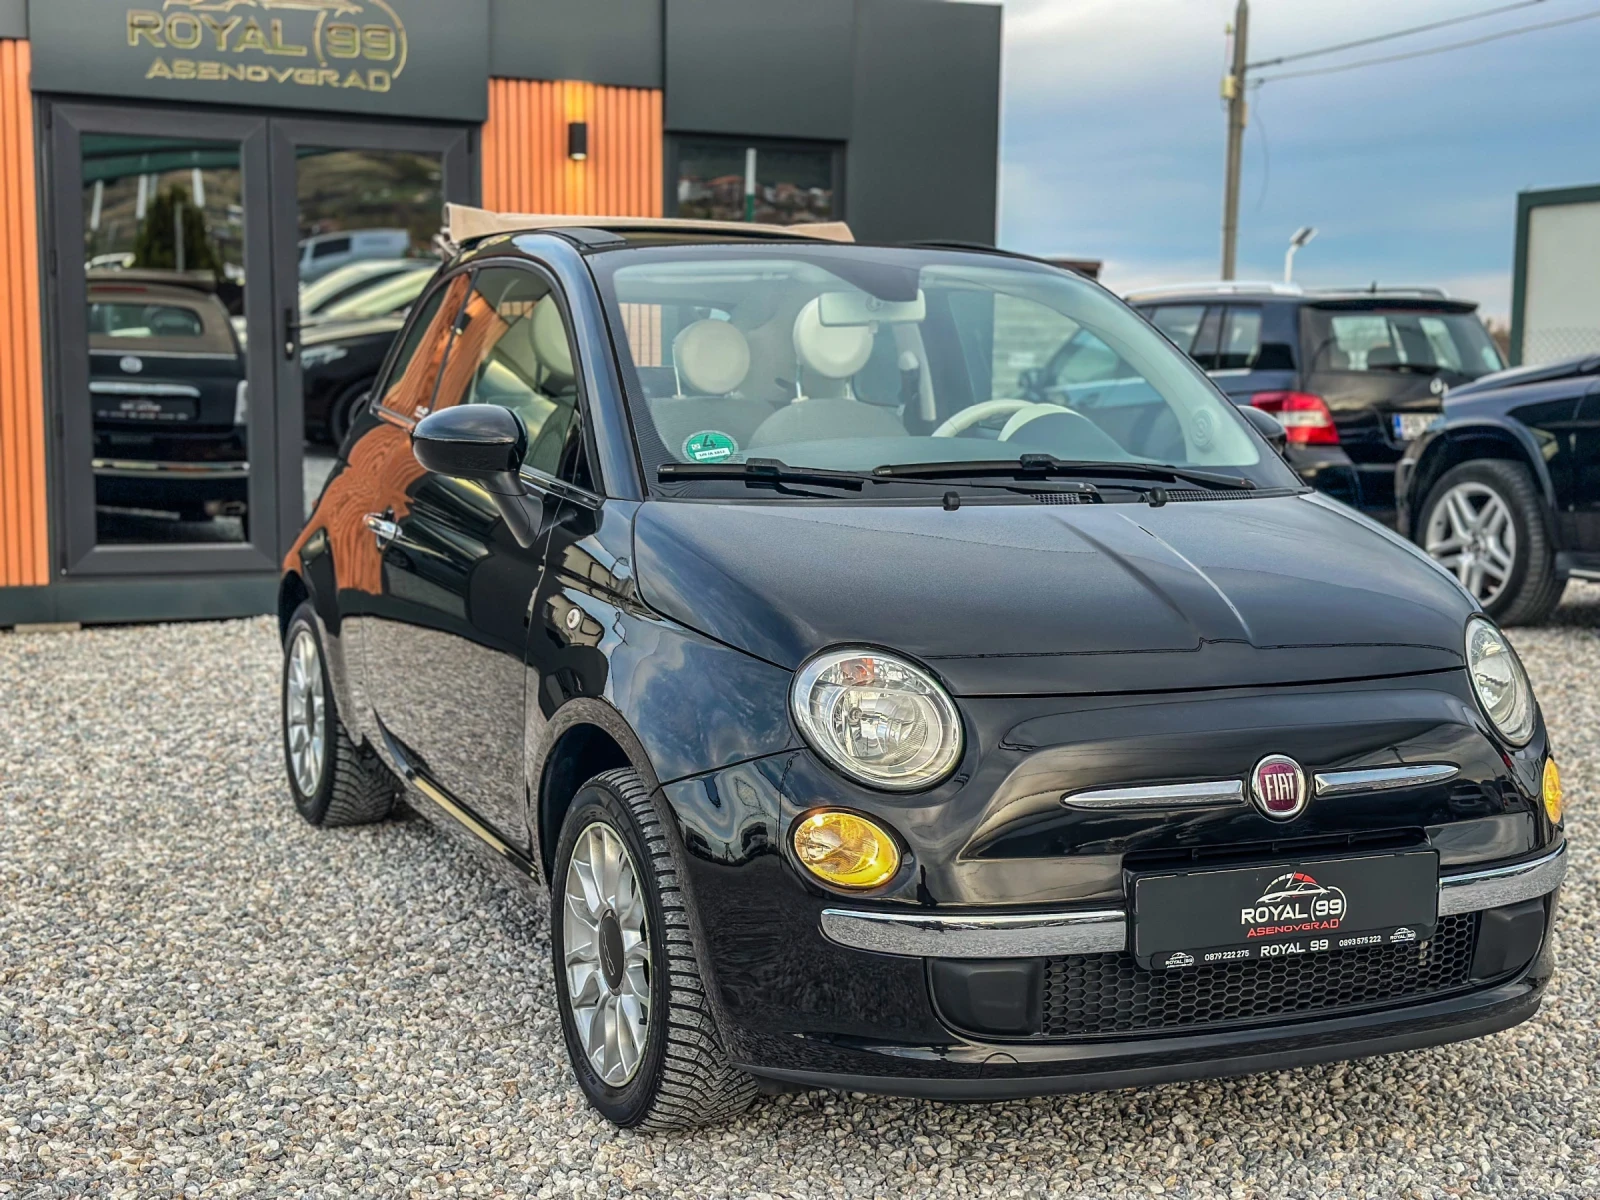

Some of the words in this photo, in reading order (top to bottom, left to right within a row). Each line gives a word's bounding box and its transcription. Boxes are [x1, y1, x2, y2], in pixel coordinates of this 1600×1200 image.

[127, 9, 308, 56] ROYAL
[145, 56, 391, 93] ASENOVGRAD
[1264, 772, 1295, 802] FIAT
[1240, 903, 1309, 925] ROYAL
[1246, 918, 1340, 938] ASENOVGRAD
[1260, 942, 1306, 957] ROYAL
[1309, 939, 1329, 952] 99
[1338, 939, 1356, 948] 0893
[1356, 937, 1369, 946] 575
[1368, 935, 1382, 944] 222
[1204, 953, 1222, 961] 0879
[1222, 951, 1236, 960] 222
[1236, 949, 1250, 958] 275
